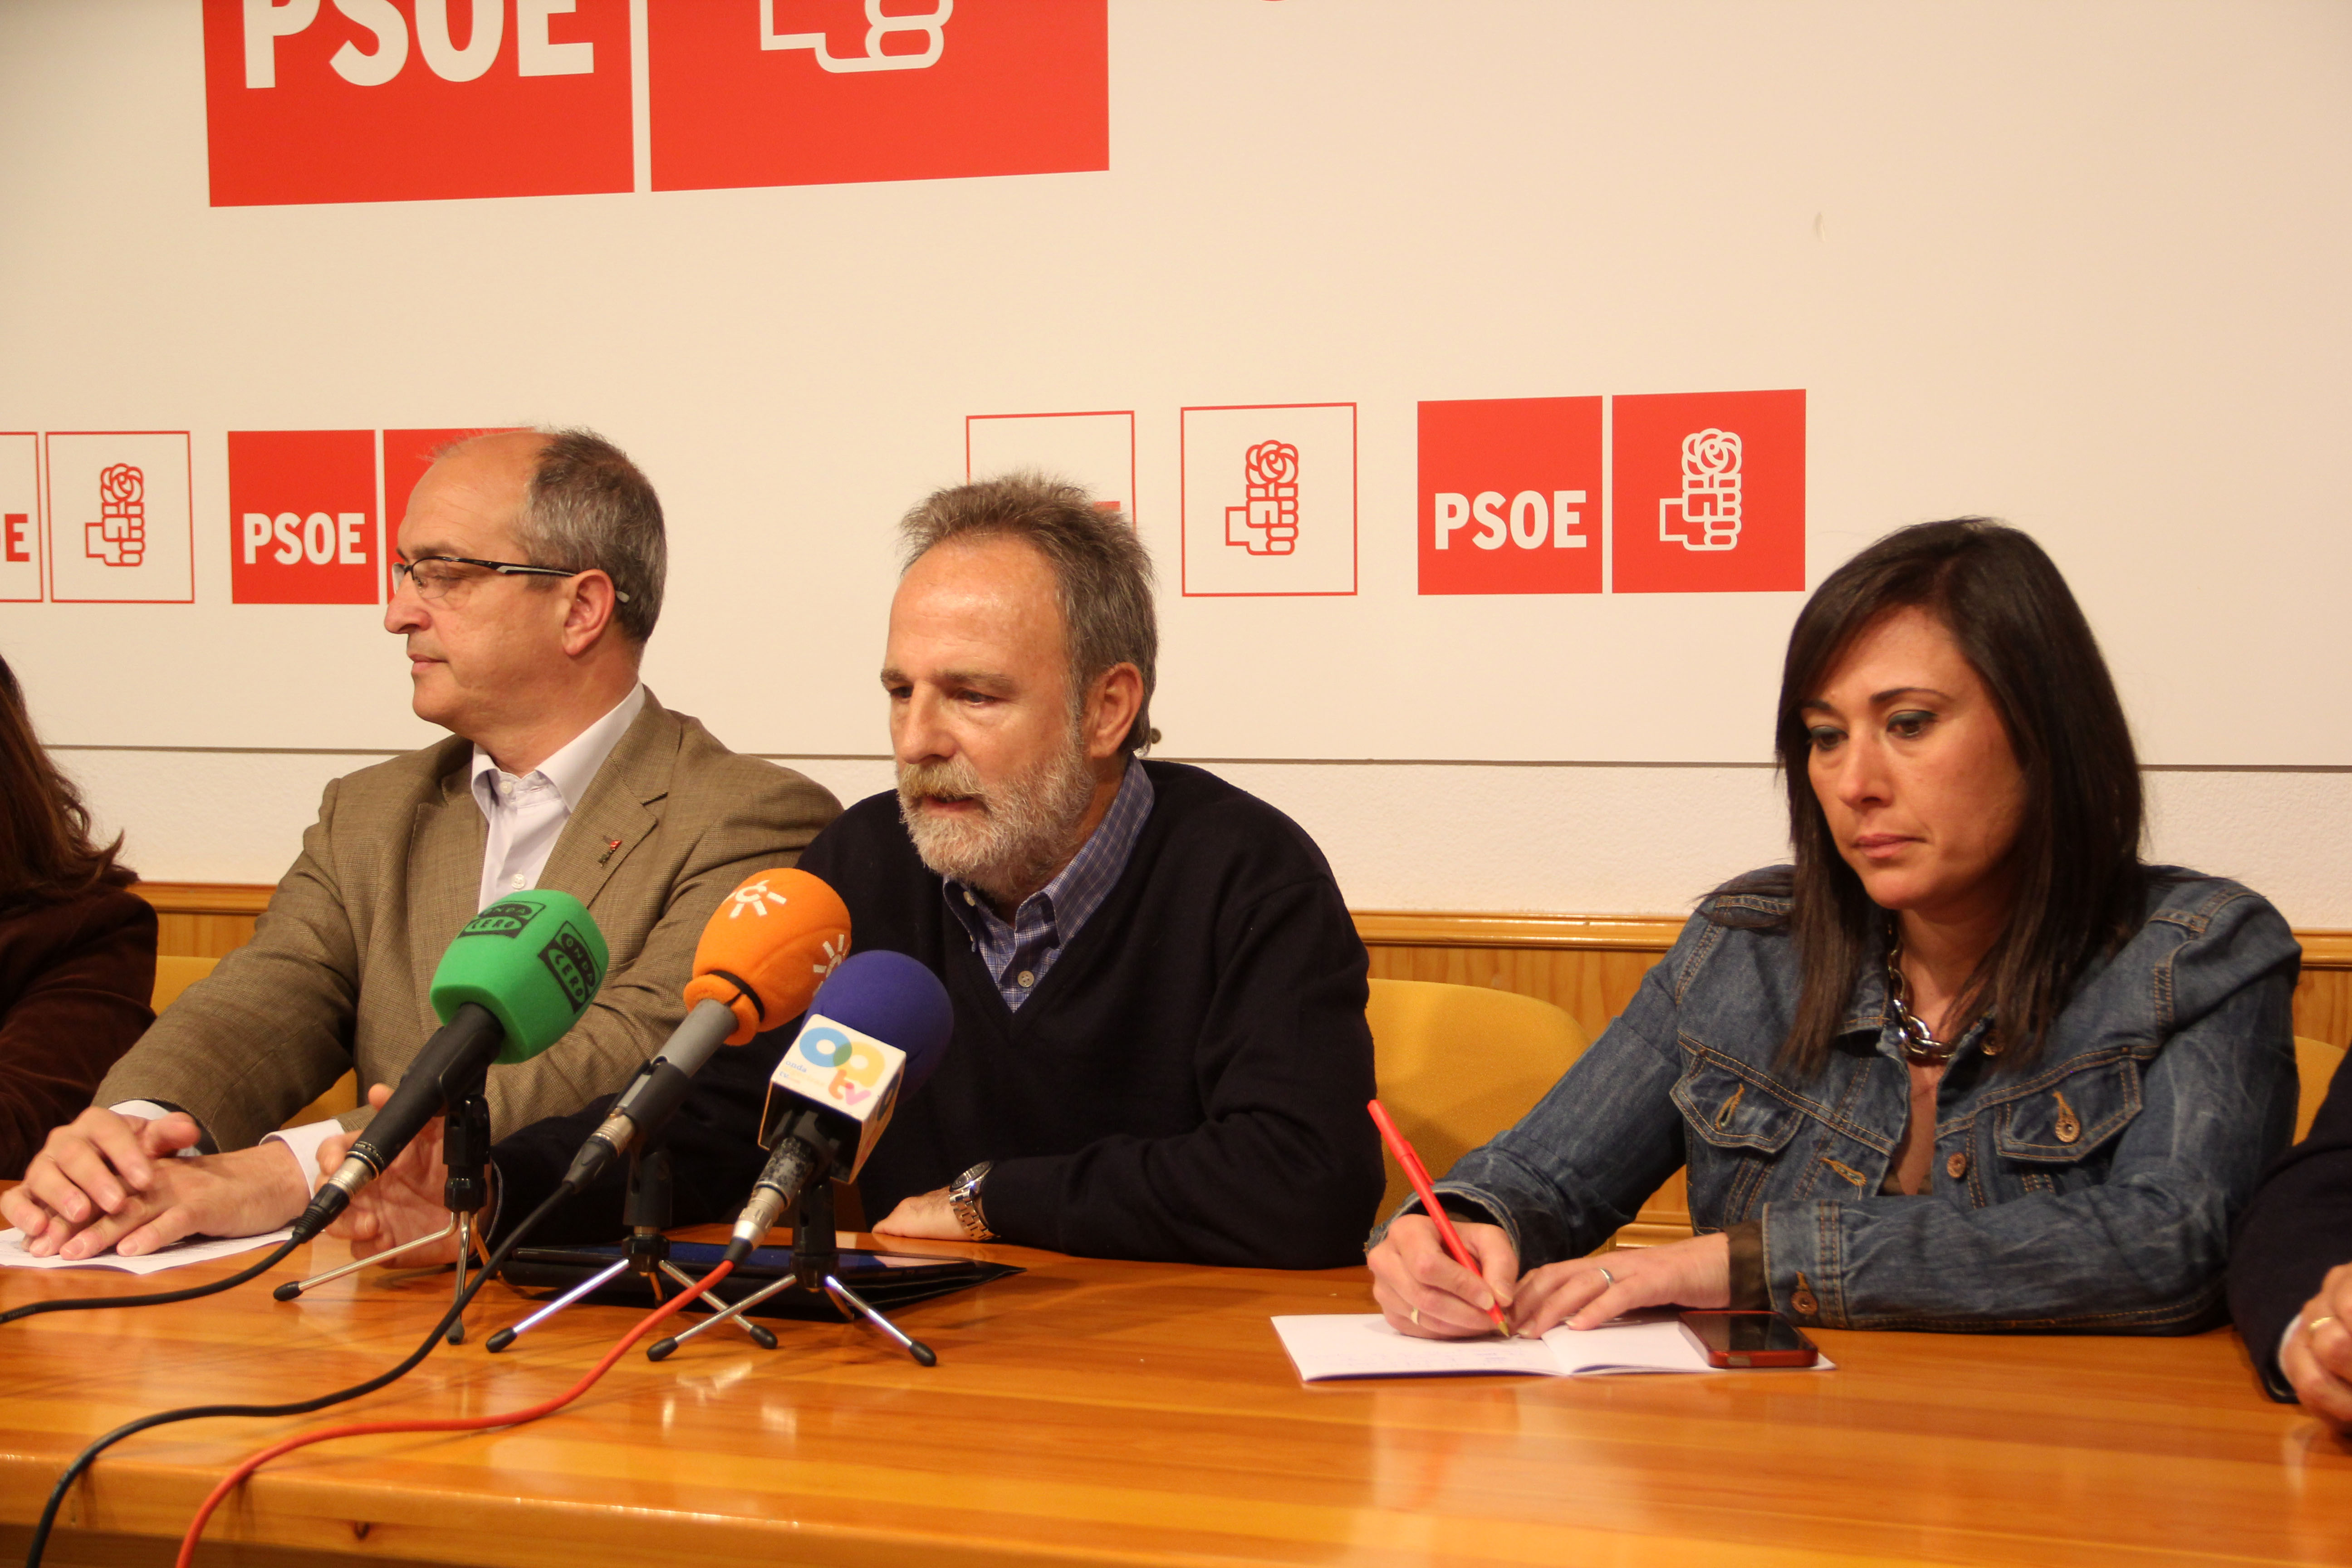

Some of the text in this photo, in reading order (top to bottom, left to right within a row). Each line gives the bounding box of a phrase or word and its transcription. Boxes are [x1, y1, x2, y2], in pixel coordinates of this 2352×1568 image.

[243, 512, 367, 565] PSOE
[1434, 490, 1587, 550] PSOE
[554, 954, 583, 997] CERO
